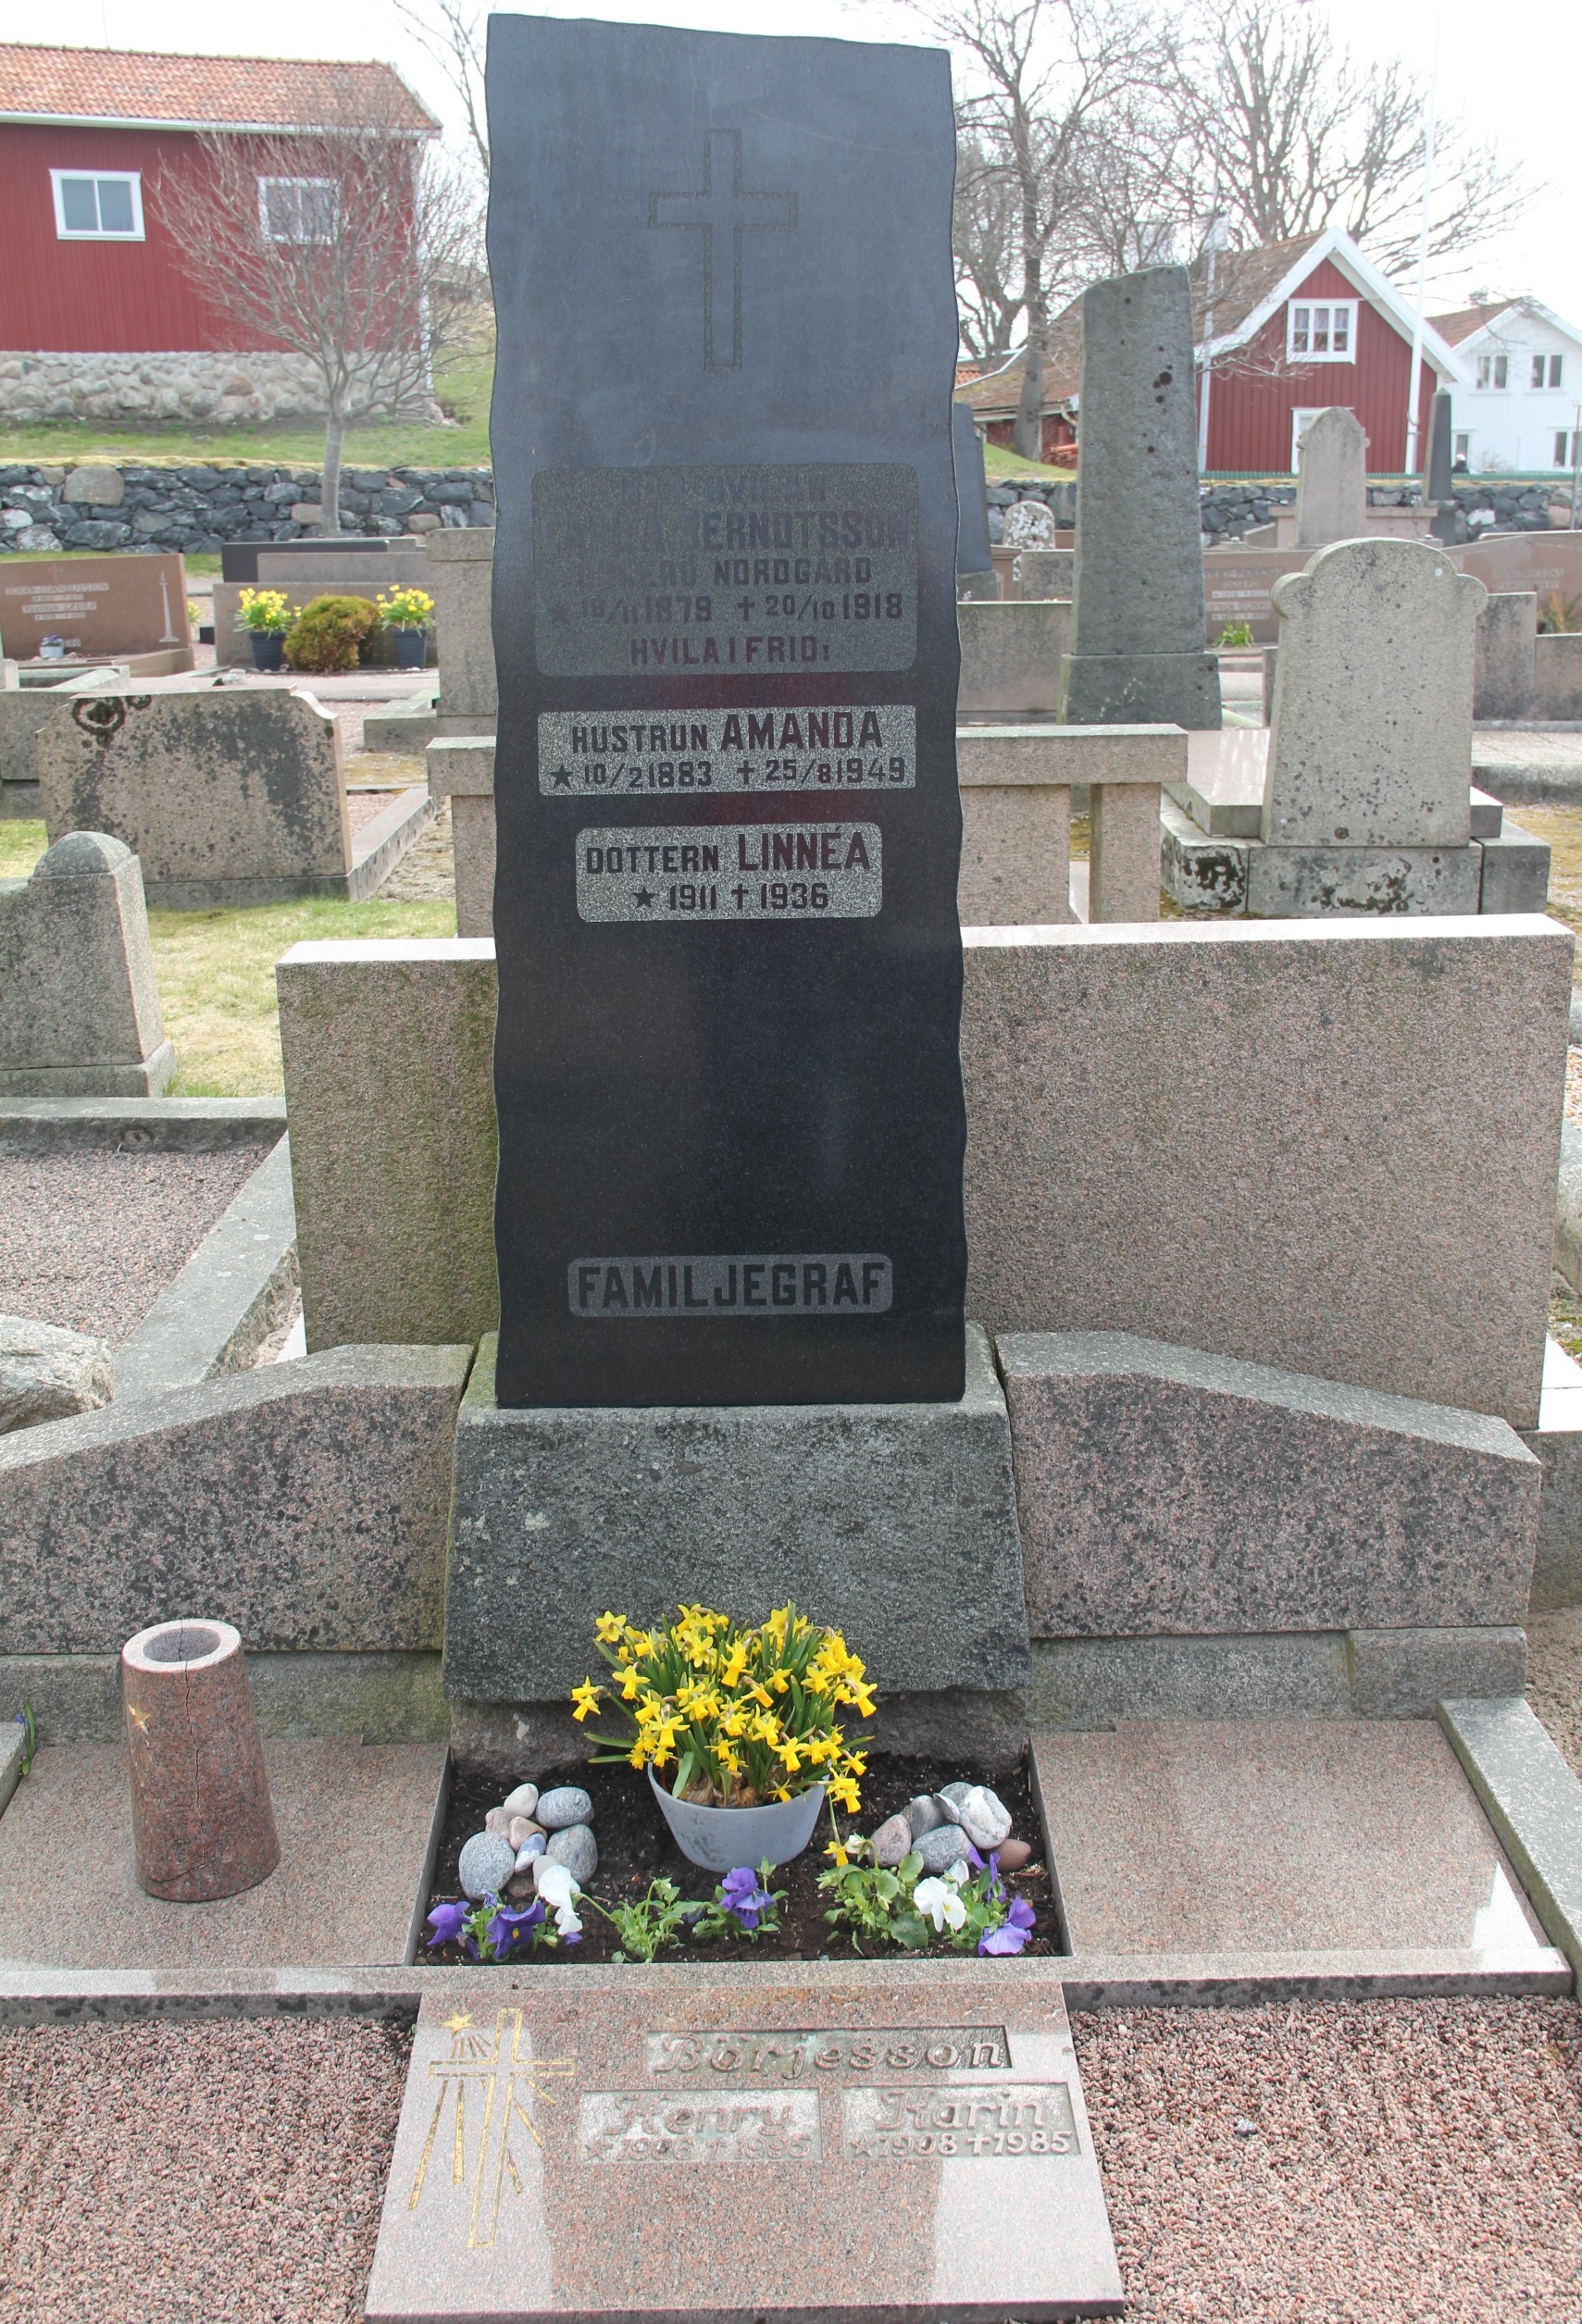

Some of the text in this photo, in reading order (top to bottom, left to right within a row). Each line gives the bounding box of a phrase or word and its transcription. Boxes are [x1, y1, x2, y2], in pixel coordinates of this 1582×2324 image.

[630, 636, 720, 665] HVILA
[571, 711, 883, 754] HUSTRUN AMANDA
[586, 825, 871, 875] DOTTERN LINNÉA
[668, 882, 829, 911] 1911 1936
[578, 1261, 885, 1309] FAMILJEGRAF
[654, 2032, 1004, 2081] Börjesson
[603, 2093, 794, 2136] Henry
[875, 2087, 1044, 2131] Karin
[878, 2131, 1073, 2157] 1908 1985
